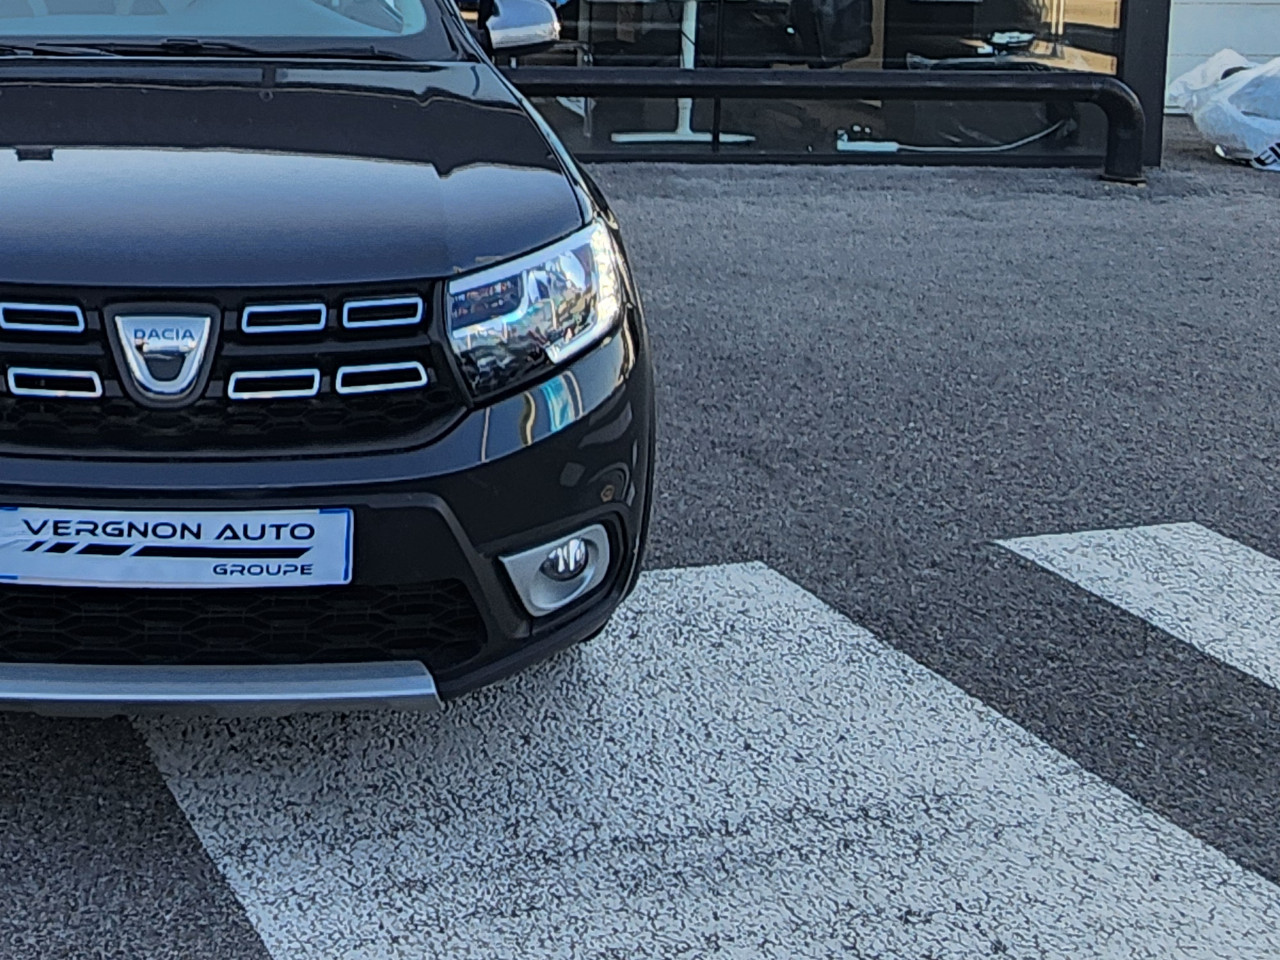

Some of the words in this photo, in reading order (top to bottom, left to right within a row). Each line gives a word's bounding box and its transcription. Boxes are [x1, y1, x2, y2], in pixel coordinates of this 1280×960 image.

[133, 328, 196, 341] DACIA
[21, 519, 202, 540] VERGNON
[215, 522, 316, 541] AUTO
[212, 563, 314, 577] GROUPE
